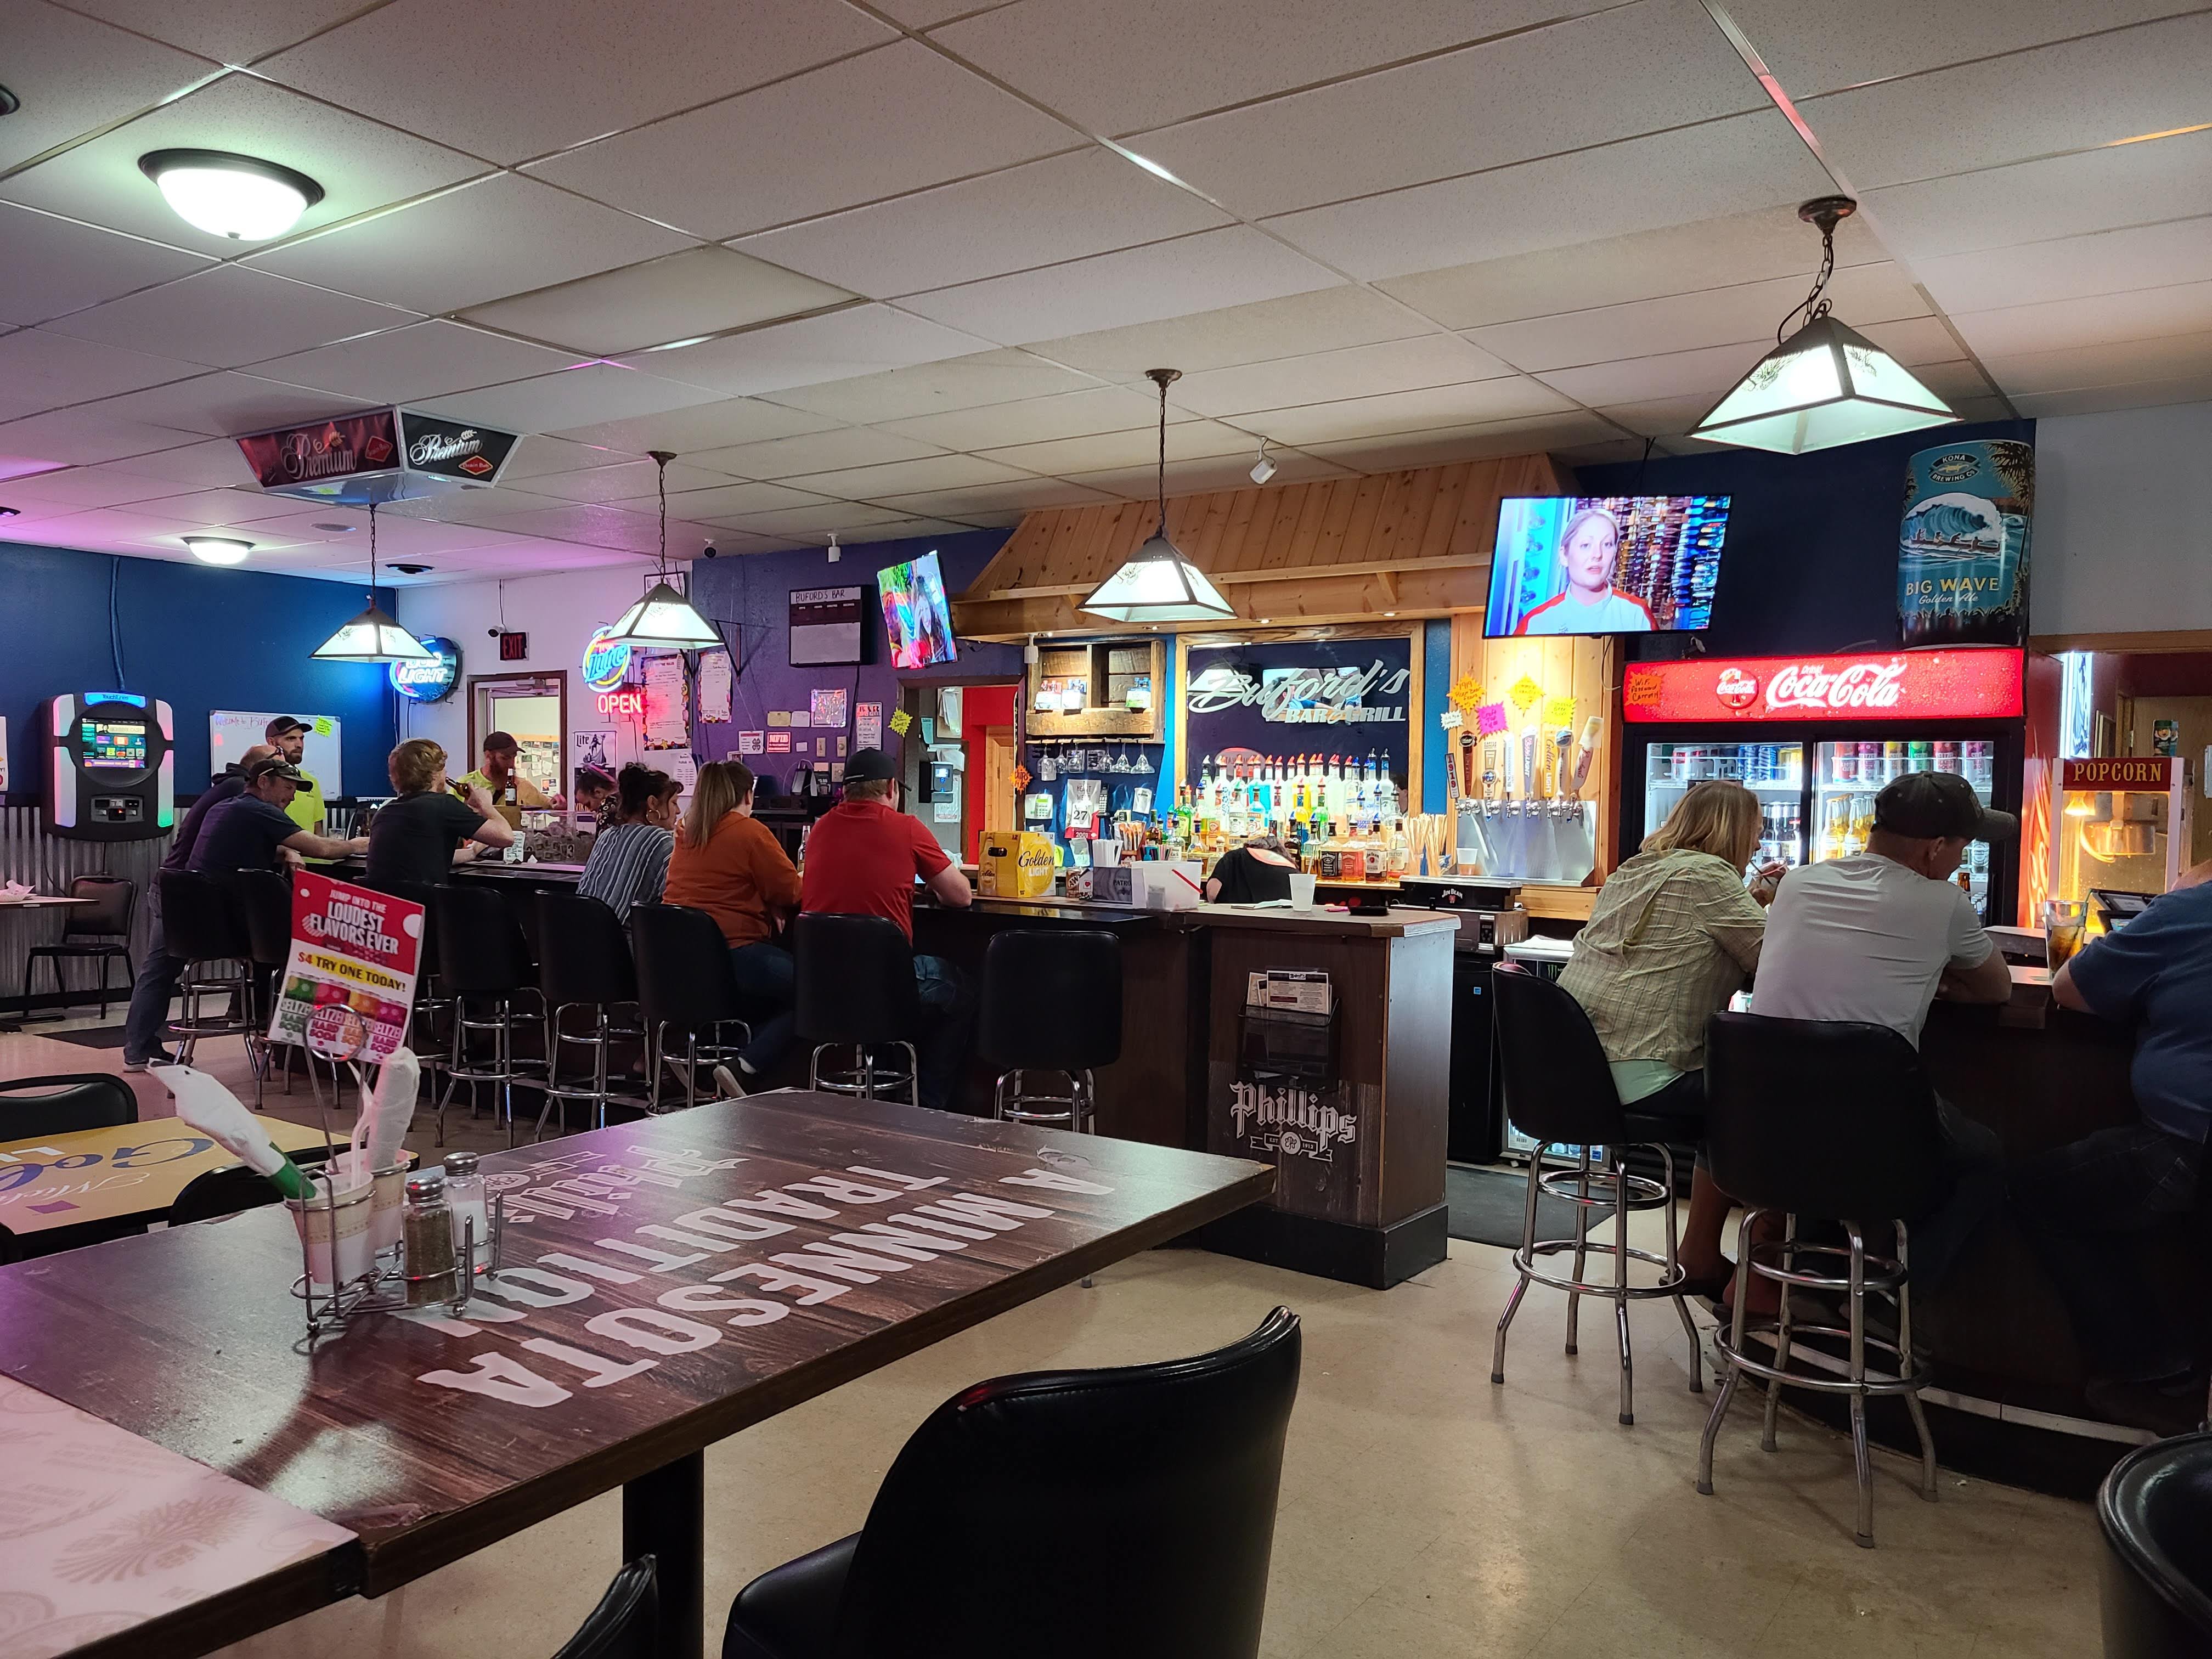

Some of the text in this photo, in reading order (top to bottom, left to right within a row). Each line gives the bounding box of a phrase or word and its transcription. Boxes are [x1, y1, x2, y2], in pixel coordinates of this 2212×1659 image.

[280, 433, 357, 479] Premium
[410, 435, 483, 465] Premium
[1942, 454, 1966, 462] KONA
[1932, 474, 1965, 482] BREWING
[832, 589, 845, 599] BAR
[1906, 577, 2000, 596] BIG WAVE
[1918, 592, 1979, 605] Golden Ale
[503, 635, 523, 659] EXIT
[397, 668, 448, 684] LIGHT
[1765, 663, 1907, 708] Coca-Cola
[1188, 659, 1410, 719] Buford's
[597, 693, 642, 714] OPEN
[1284, 709, 1329, 724] BAR
[1346, 707, 1407, 724] GRILL
[577, 734, 589, 747] Lite
[1546, 738, 1554, 771] Golden
[2073, 762, 2162, 782] POPCORN
[1073, 810, 1087, 821] 27
[1018, 850, 1055, 868] Golden
[1029, 867, 1049, 877] LIGHT
[330, 889, 387, 913] JUMP INTO THE
[1442, 888, 1463, 899] JIM BEAM
[328, 901, 385, 933] LOUDEST
[309, 912, 399, 955] FLAVORS EVER
[298, 952, 313, 965] $4
[315, 956, 337, 972] TRY
[339, 964, 363, 979] ONE
[365, 971, 406, 992] TODAY!
[308, 1029, 337, 1042] SODA
[1229, 1081, 1357, 1153] Phillips
[416, 1168, 1116, 1409] A MINNESOTA
